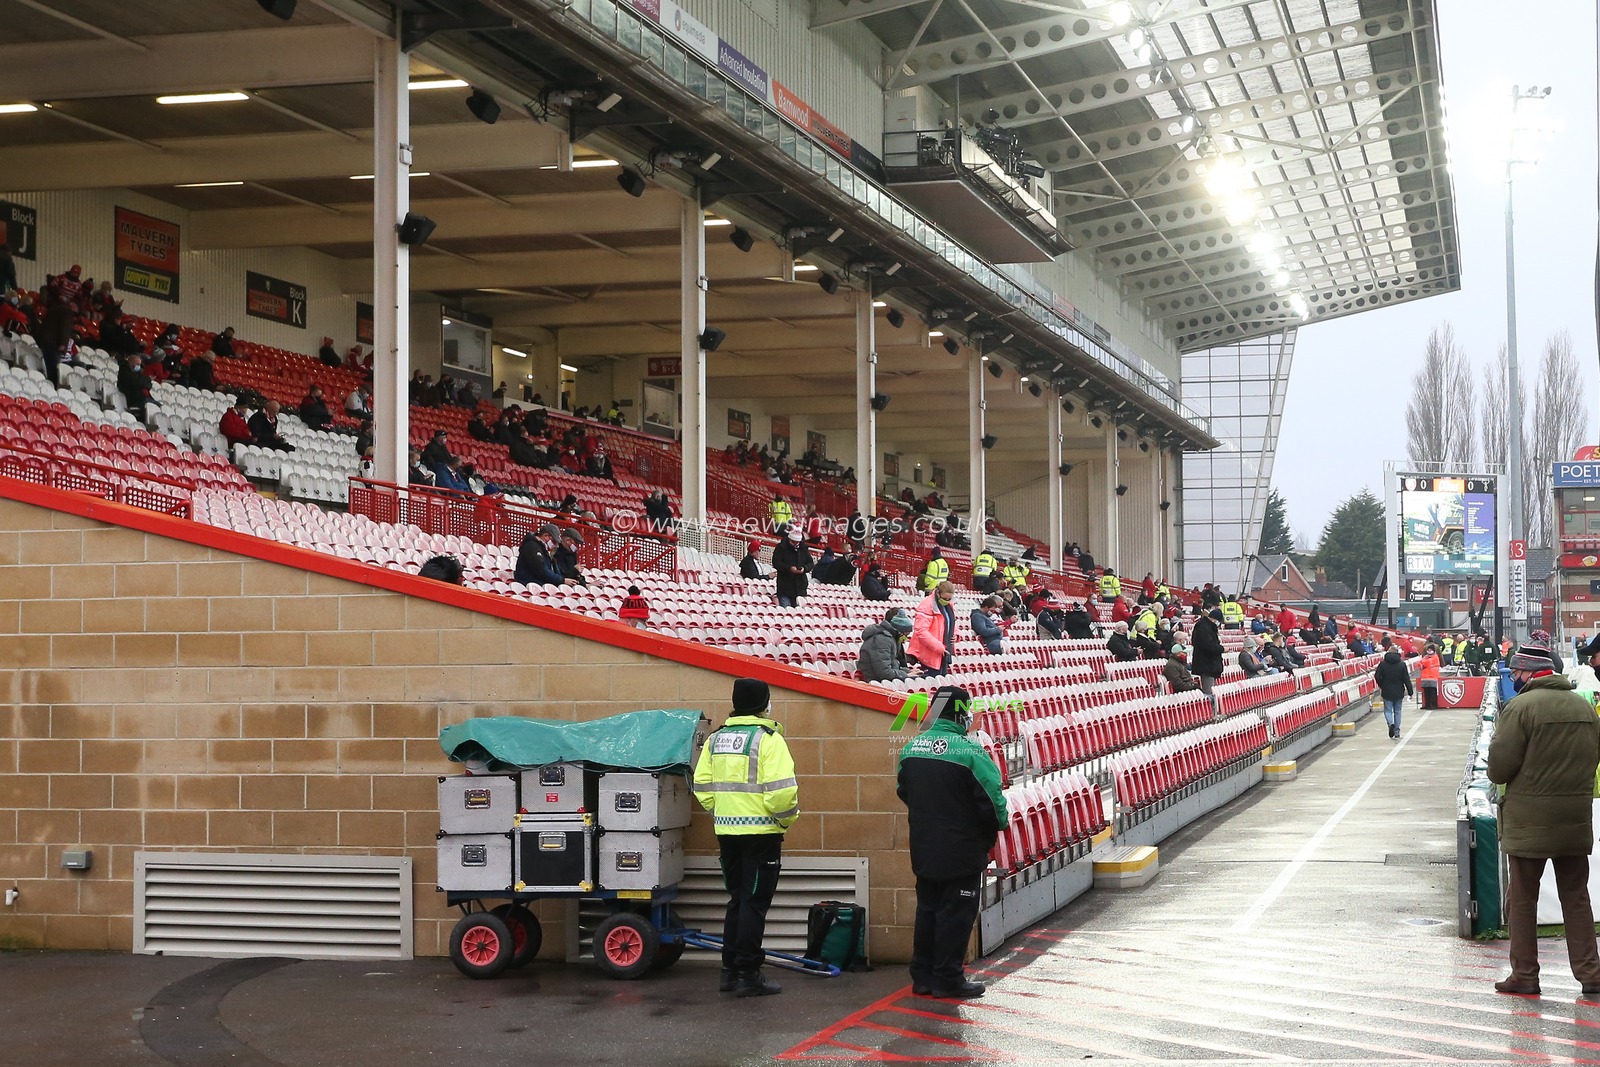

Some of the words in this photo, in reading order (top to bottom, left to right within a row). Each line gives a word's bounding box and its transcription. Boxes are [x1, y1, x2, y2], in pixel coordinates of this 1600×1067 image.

[719, 47, 743, 77] Advanced
[743, 63, 767, 95] Insulation
[12, 208, 35, 226] Block
[19, 226, 28, 253] J
[121, 221, 175, 247] MALVERN
[130, 240, 166, 260] TYRES
[289, 287, 305, 300] Block
[292, 301, 302, 324] K
[1515, 543, 1524, 558] 3
[1407, 556, 1433, 569] RTW
[1514, 564, 1523, 614] SMITHS
